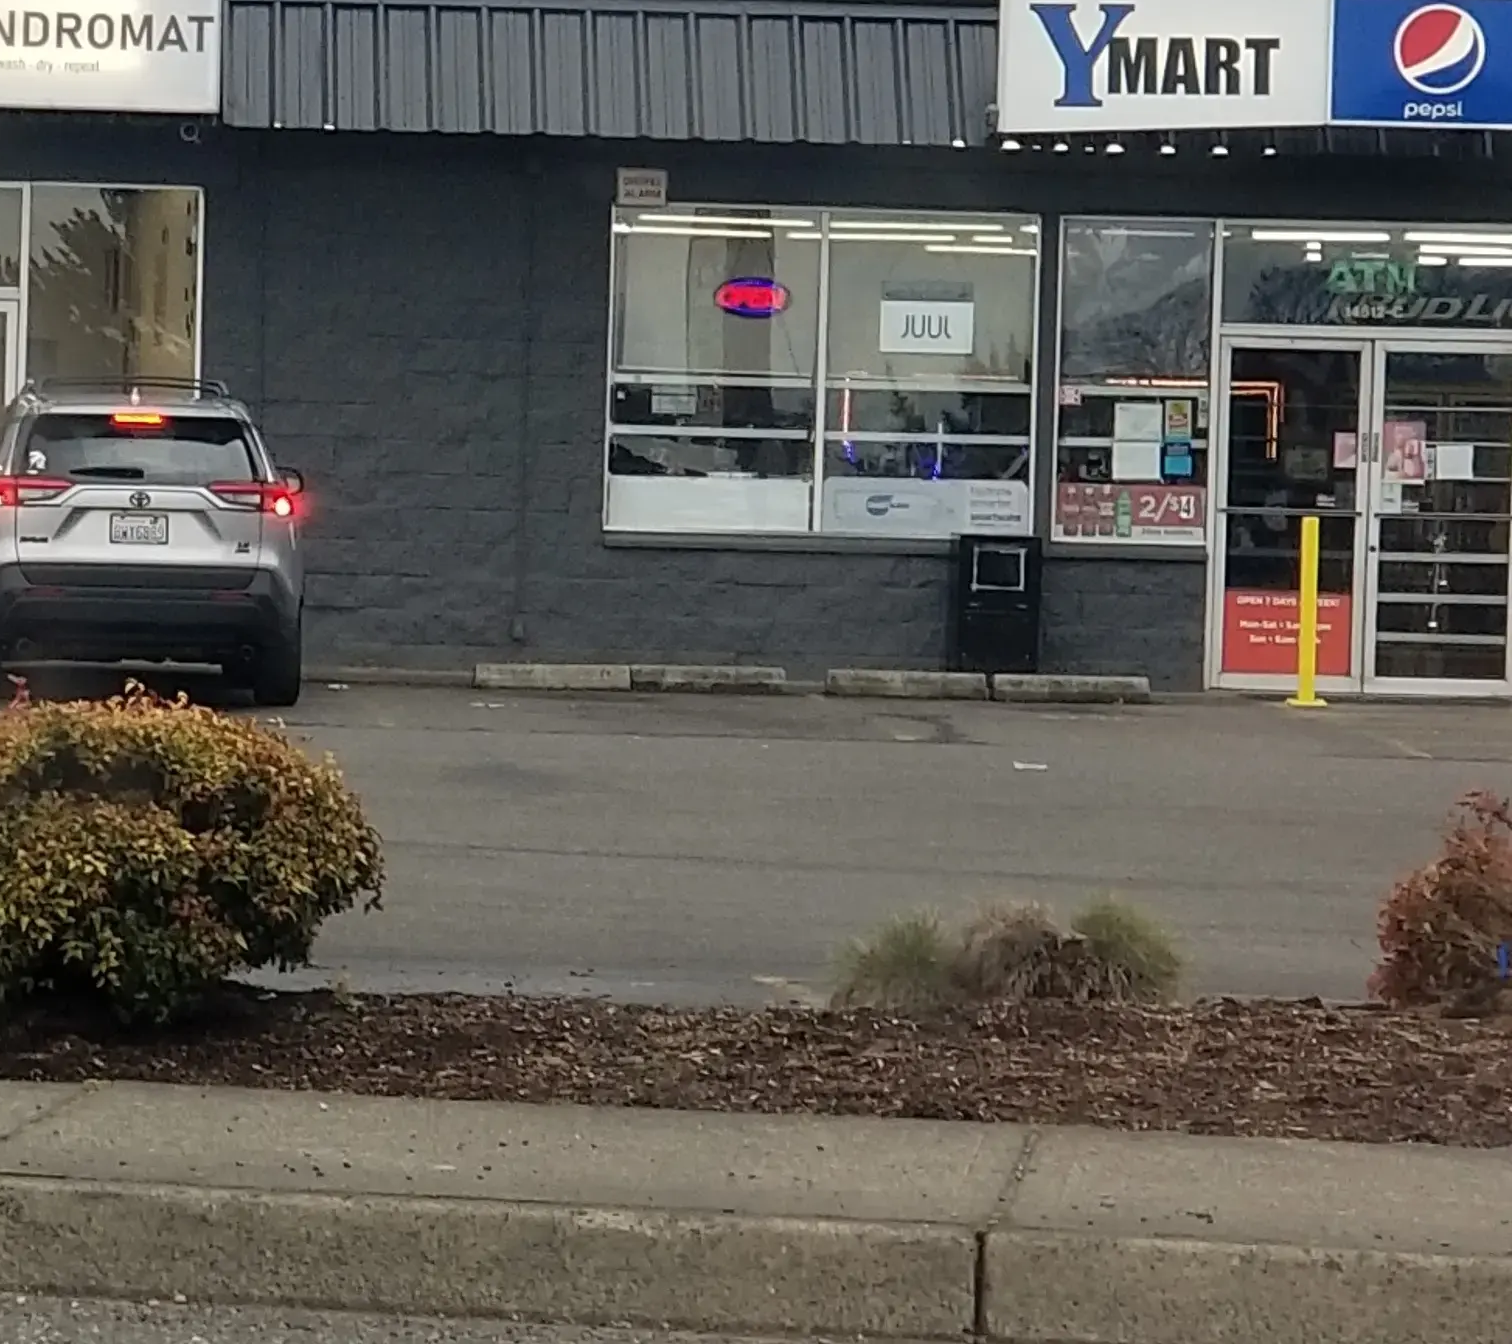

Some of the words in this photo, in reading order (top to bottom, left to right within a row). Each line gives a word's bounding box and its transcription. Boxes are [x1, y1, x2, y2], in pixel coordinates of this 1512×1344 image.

[36, 60, 53, 74] dry
[64, 61, 100, 74] repeat
[1404, 100, 1464, 119] pepsi
[900, 314, 952, 340] JUUL
[1236, 596, 1263, 605] OPEN
[1272, 597, 1297, 606] DAYS
